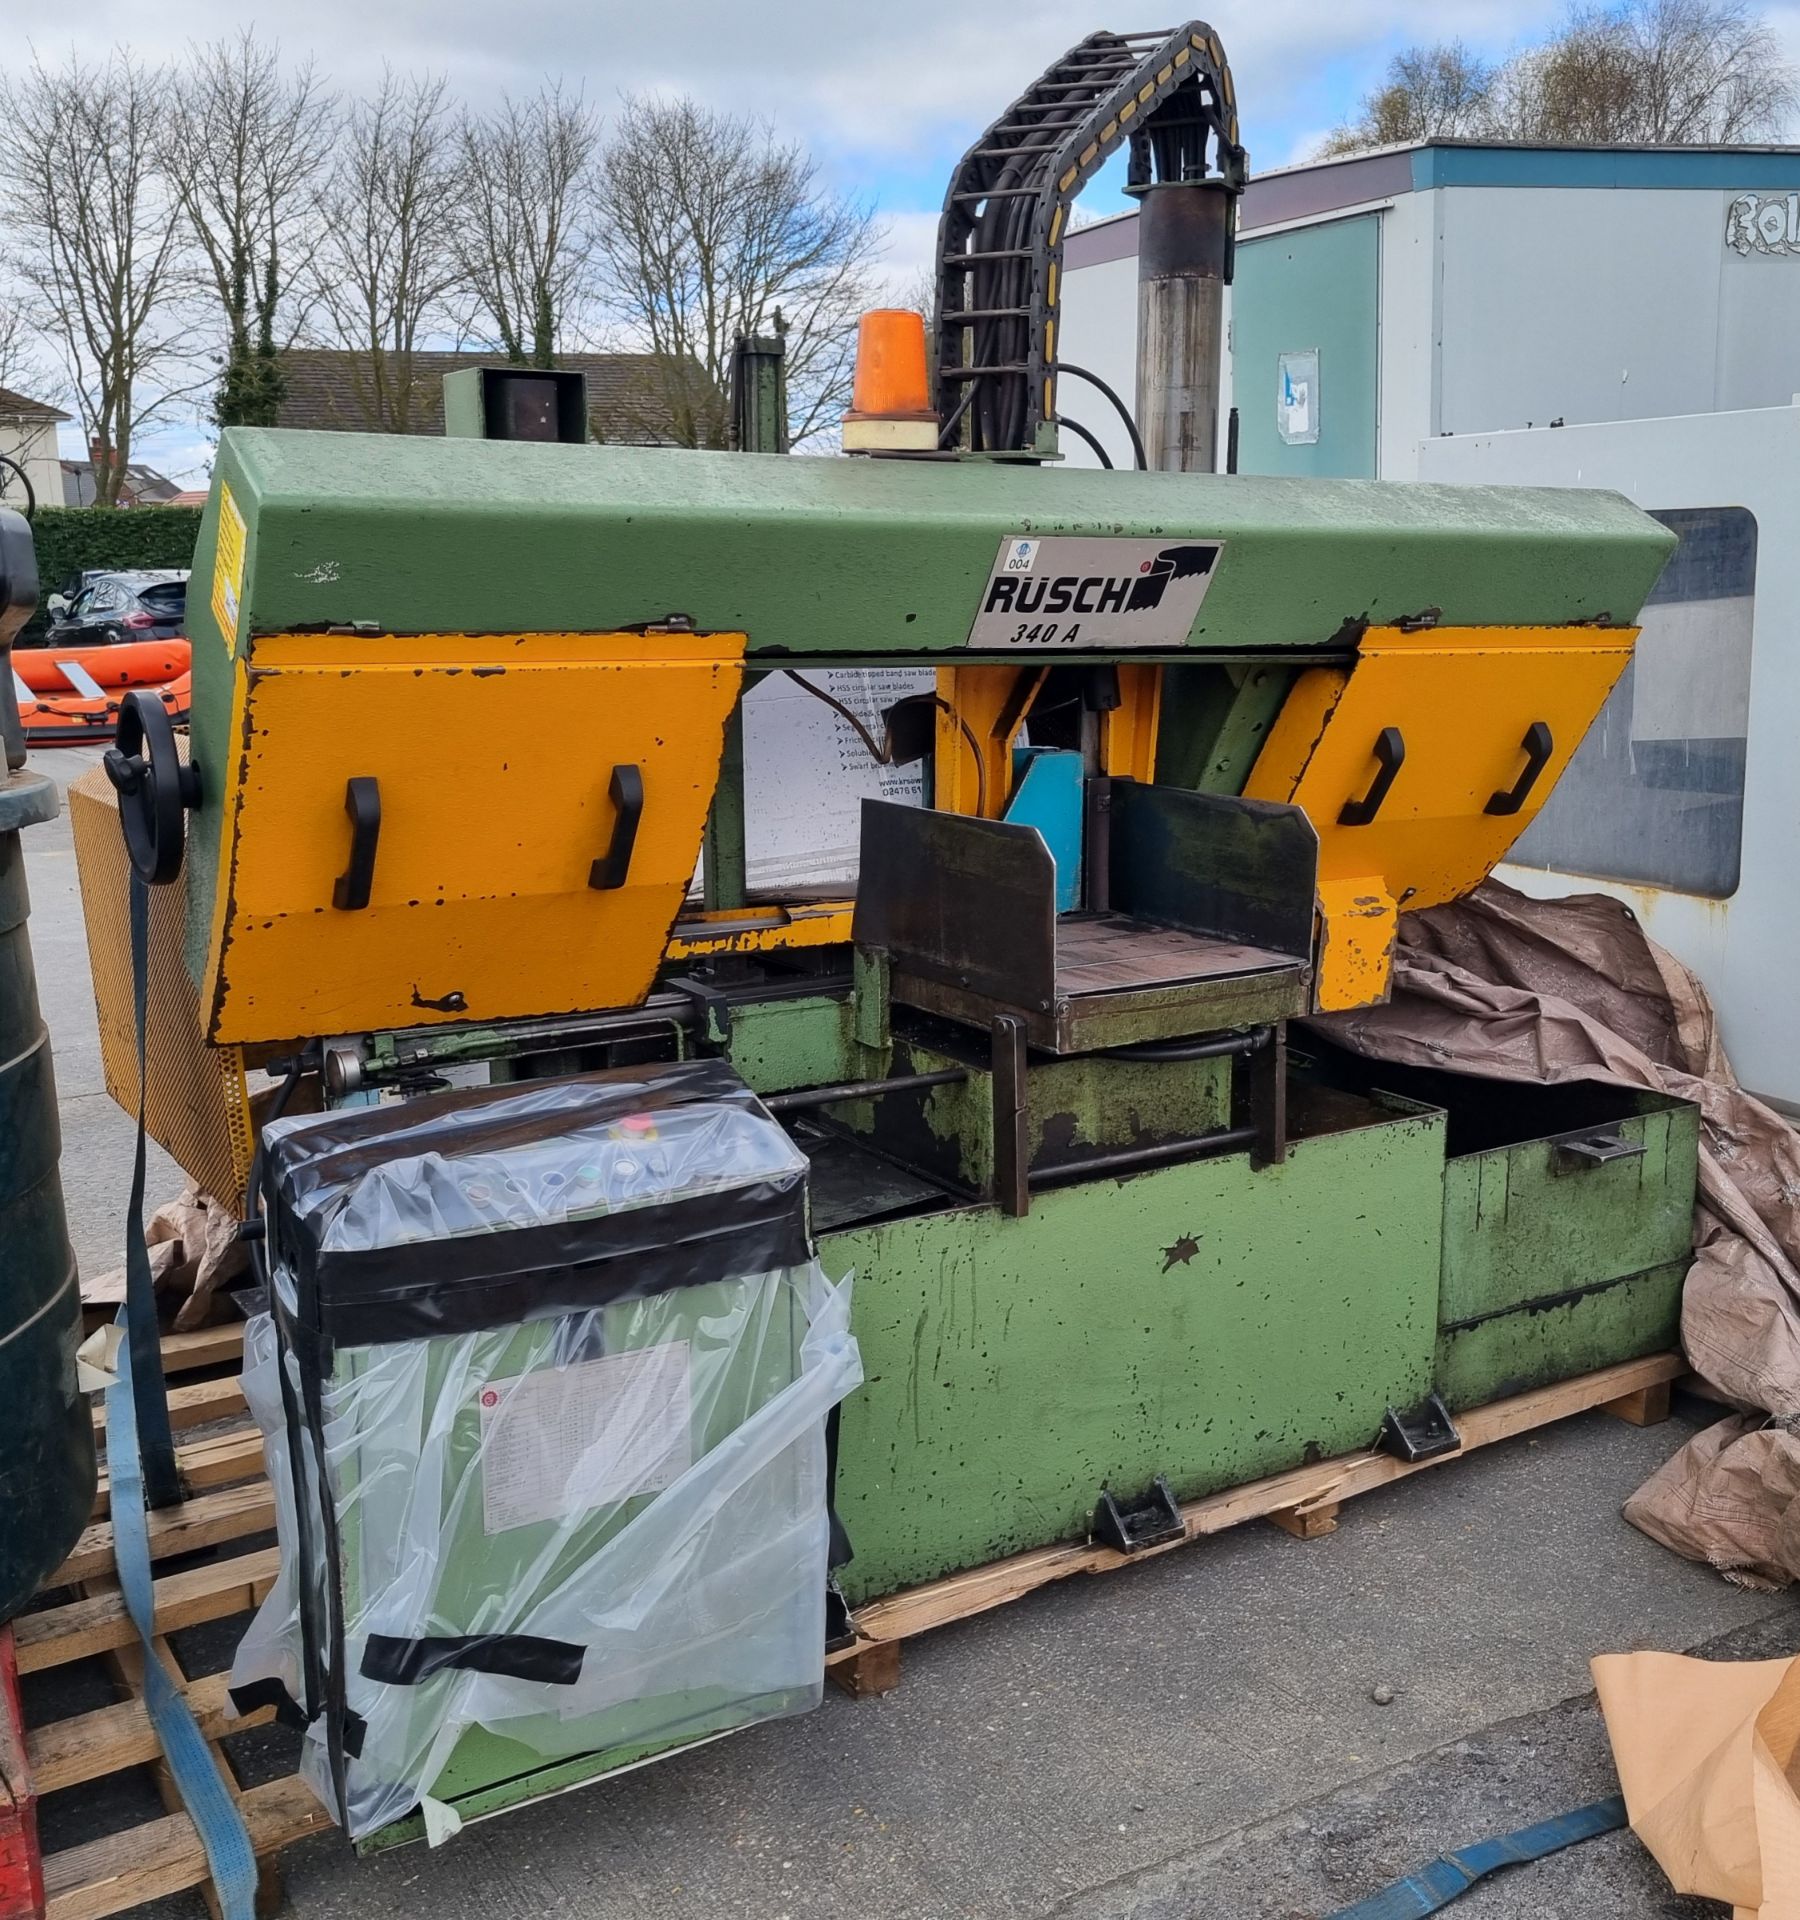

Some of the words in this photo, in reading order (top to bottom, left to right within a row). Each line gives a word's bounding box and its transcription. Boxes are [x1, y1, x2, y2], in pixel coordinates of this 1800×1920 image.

[1008, 559, 1030, 570] 004
[984, 576, 1132, 614] RÜSCH
[1010, 623, 1059, 643] 340
[1061, 623, 1081, 643] A
[892, 681, 914, 690] blades
[839, 697, 852, 705] HSS
[849, 762, 869, 771] Swarf
